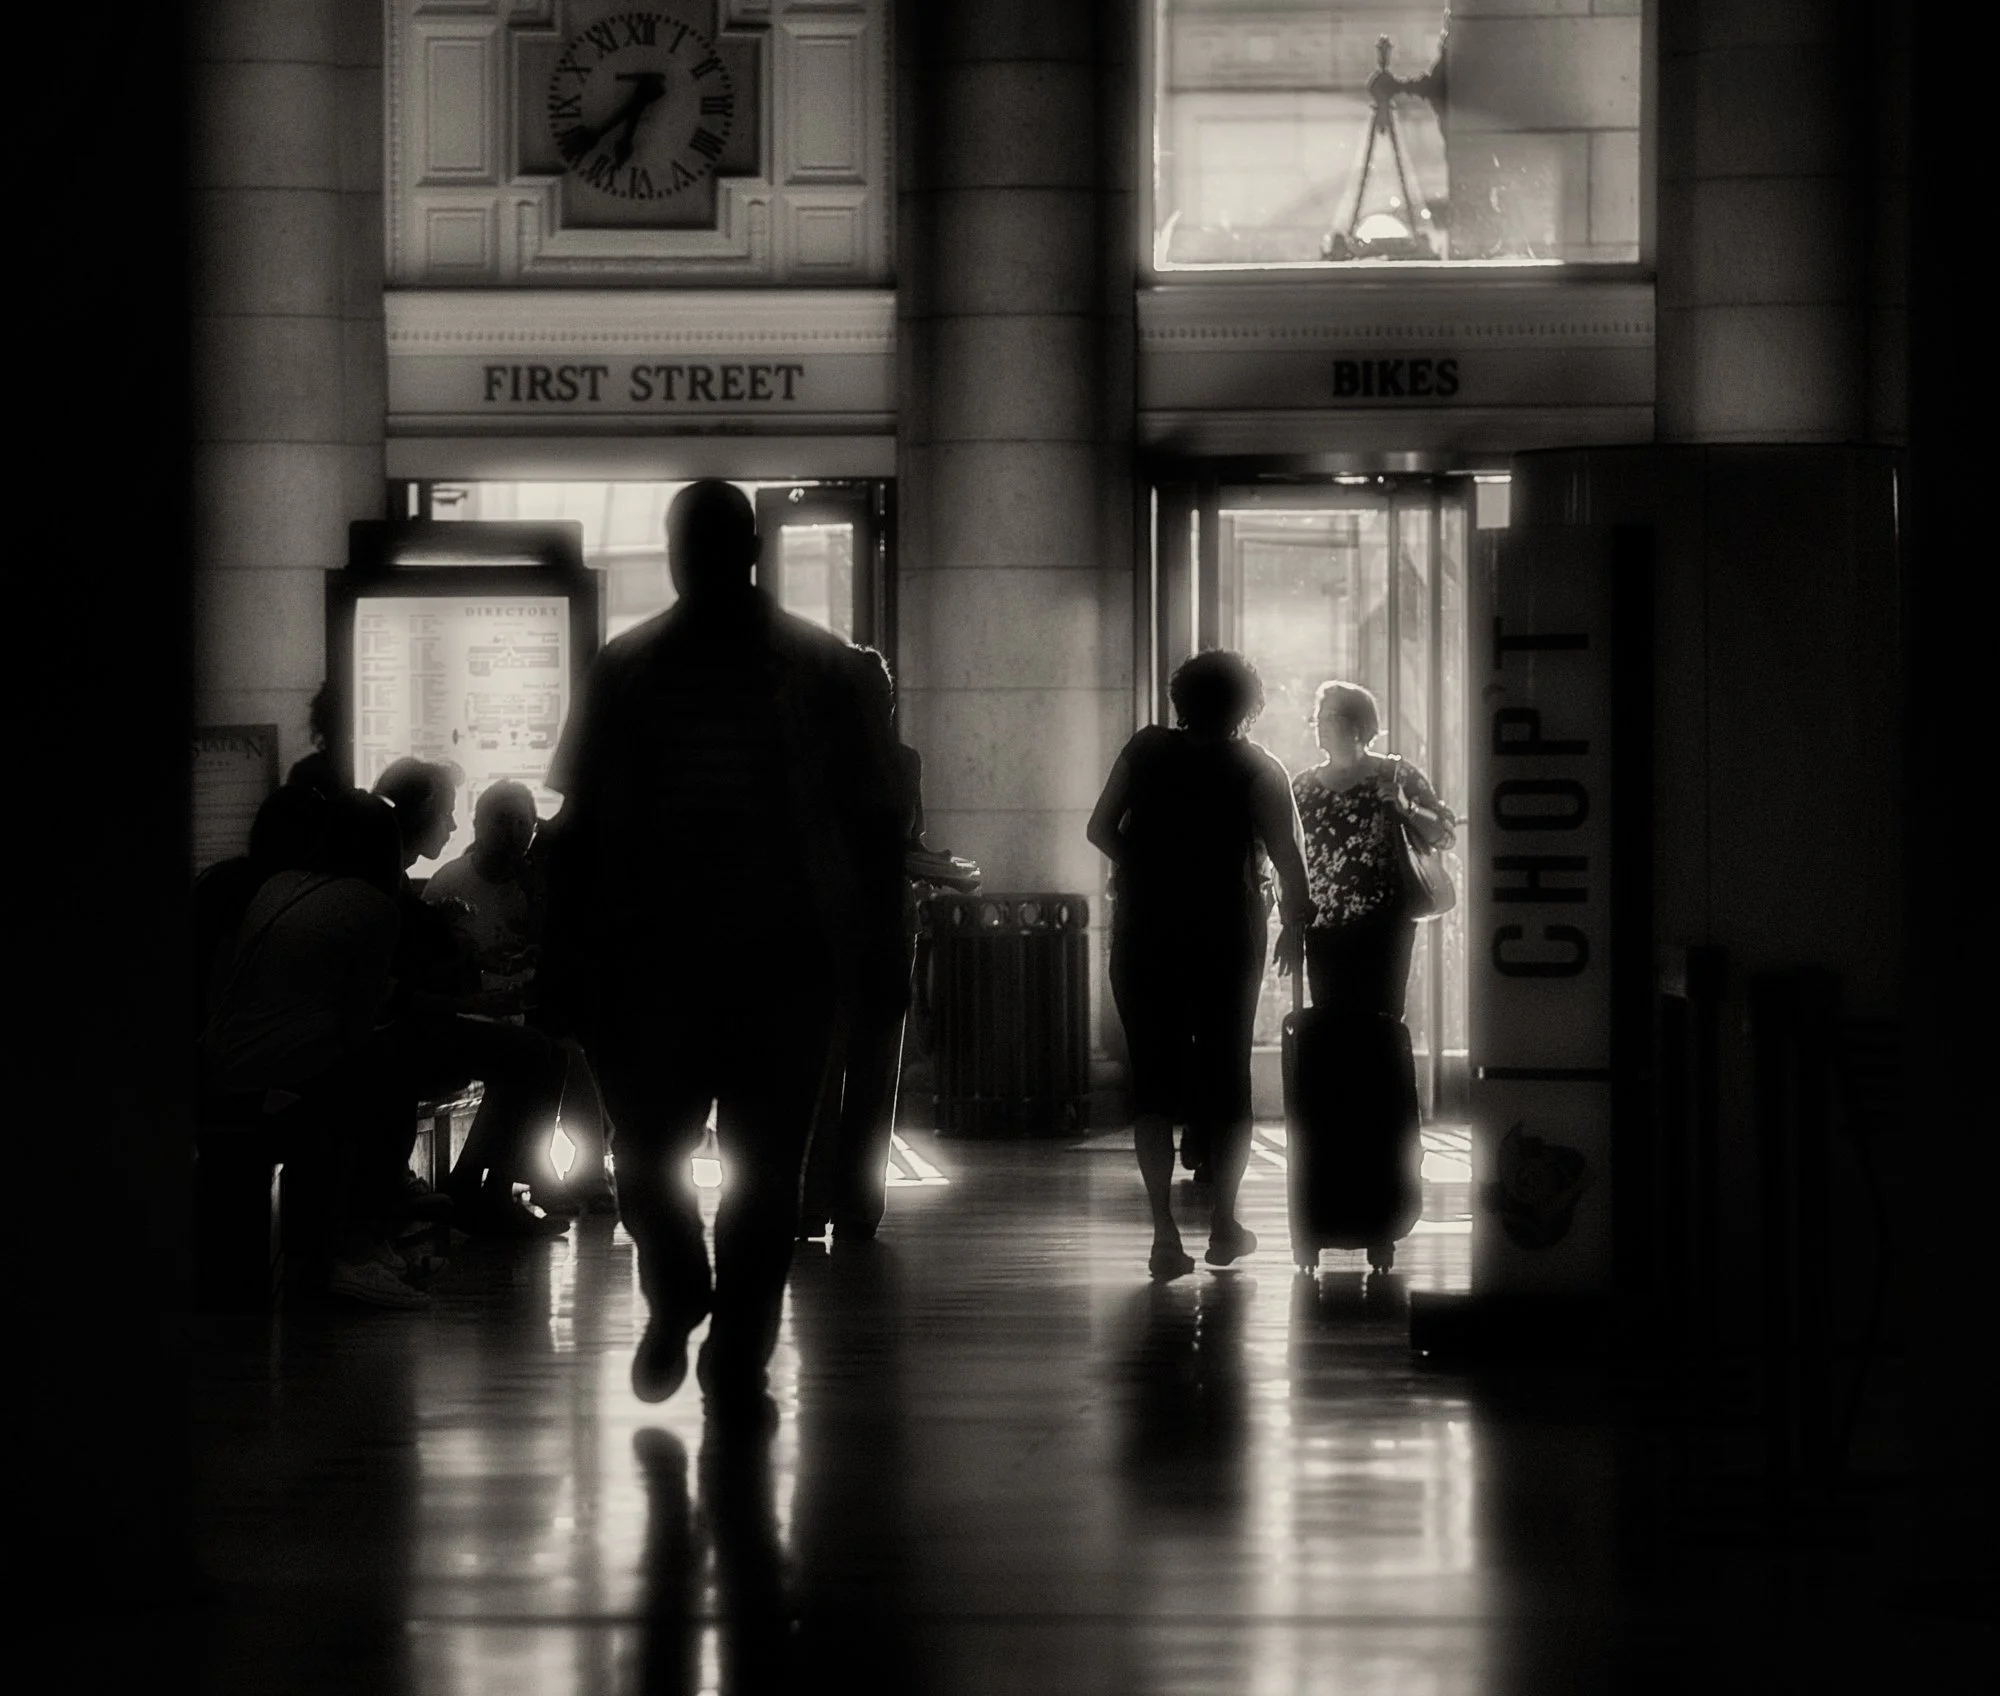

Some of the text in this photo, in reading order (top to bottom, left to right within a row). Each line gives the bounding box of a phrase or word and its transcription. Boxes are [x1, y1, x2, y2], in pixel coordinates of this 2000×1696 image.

[624, 17, 656, 46] XII
[482, 364, 804, 402] FIRST STREET
[1332, 358, 1460, 397] BIKES
[464, 606, 560, 617] DIRECTORY
